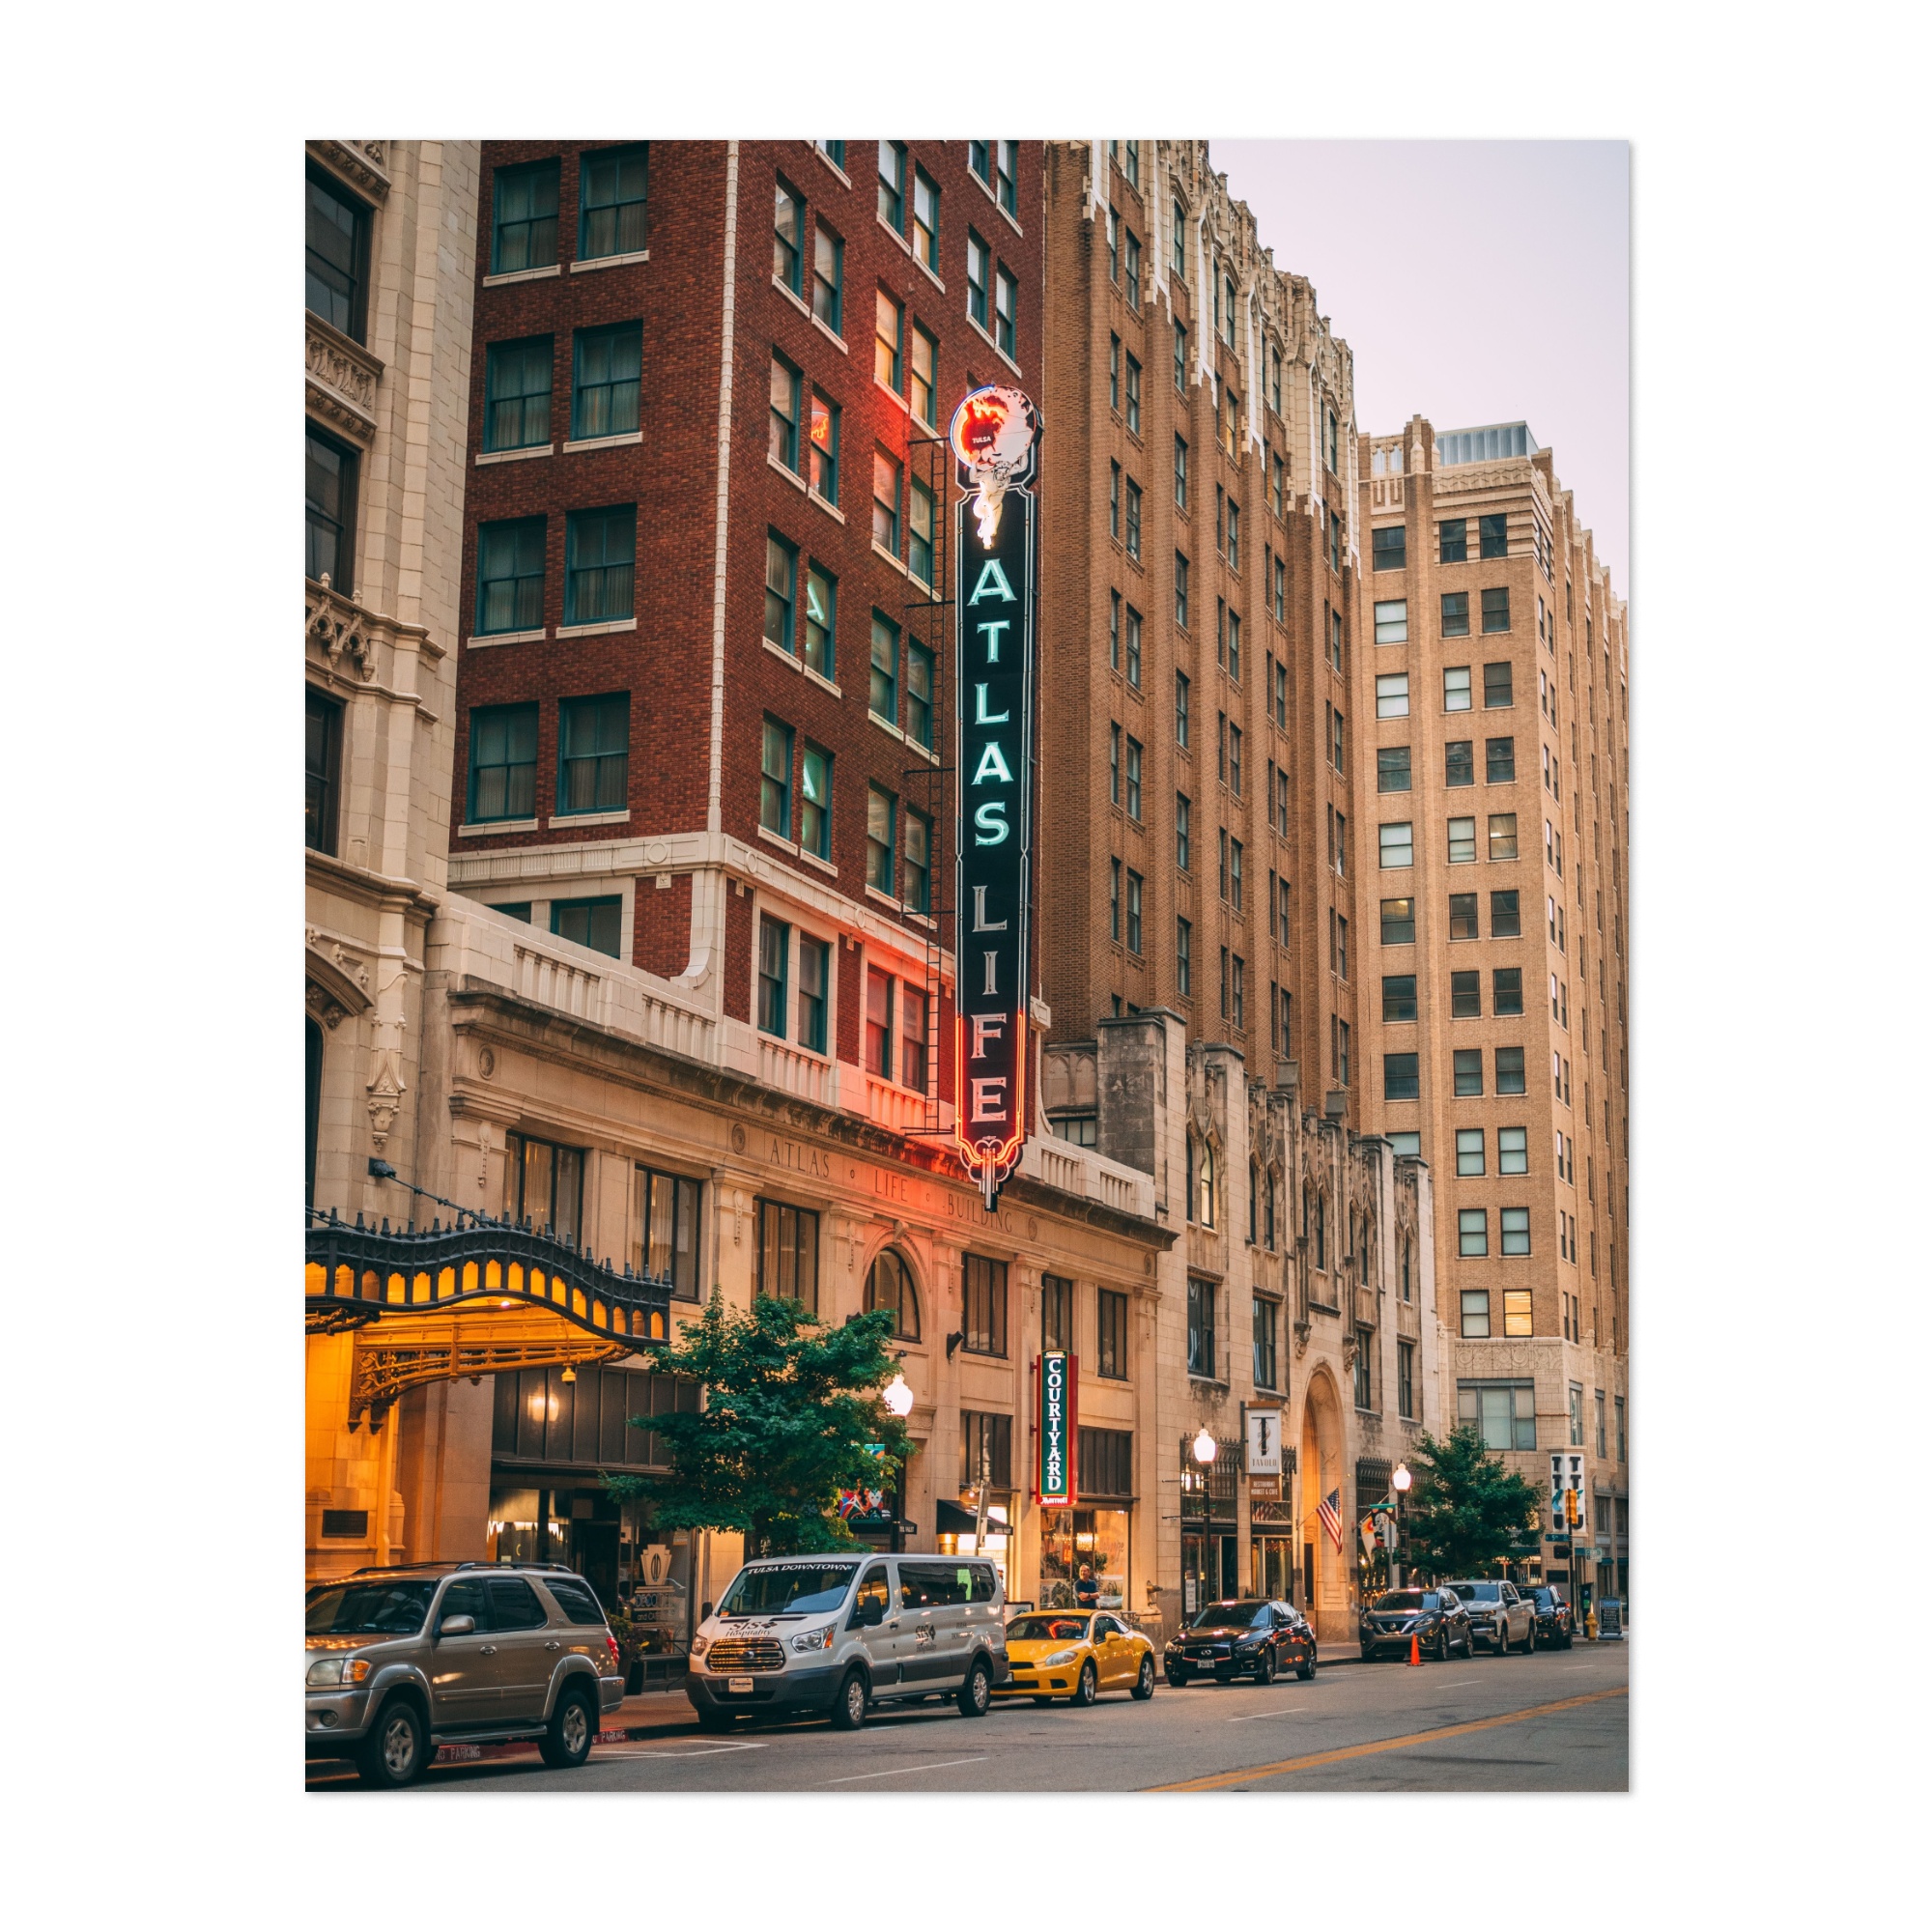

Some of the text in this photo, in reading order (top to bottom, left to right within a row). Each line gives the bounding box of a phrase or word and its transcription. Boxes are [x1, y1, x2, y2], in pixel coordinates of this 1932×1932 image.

[967, 558, 1017, 1122] ATLAS LIFE
[770, 1138, 1011, 1233] ATLAS LIFE BUILDING
[1047, 1359, 1062, 1491] COURTYARD
[748, 1565, 779, 1575] TULSA
[725, 1629, 773, 1637] Hospitality
[601, 1730, 625, 1742] PARKING
[450, 1747, 481, 1760] PARKING
